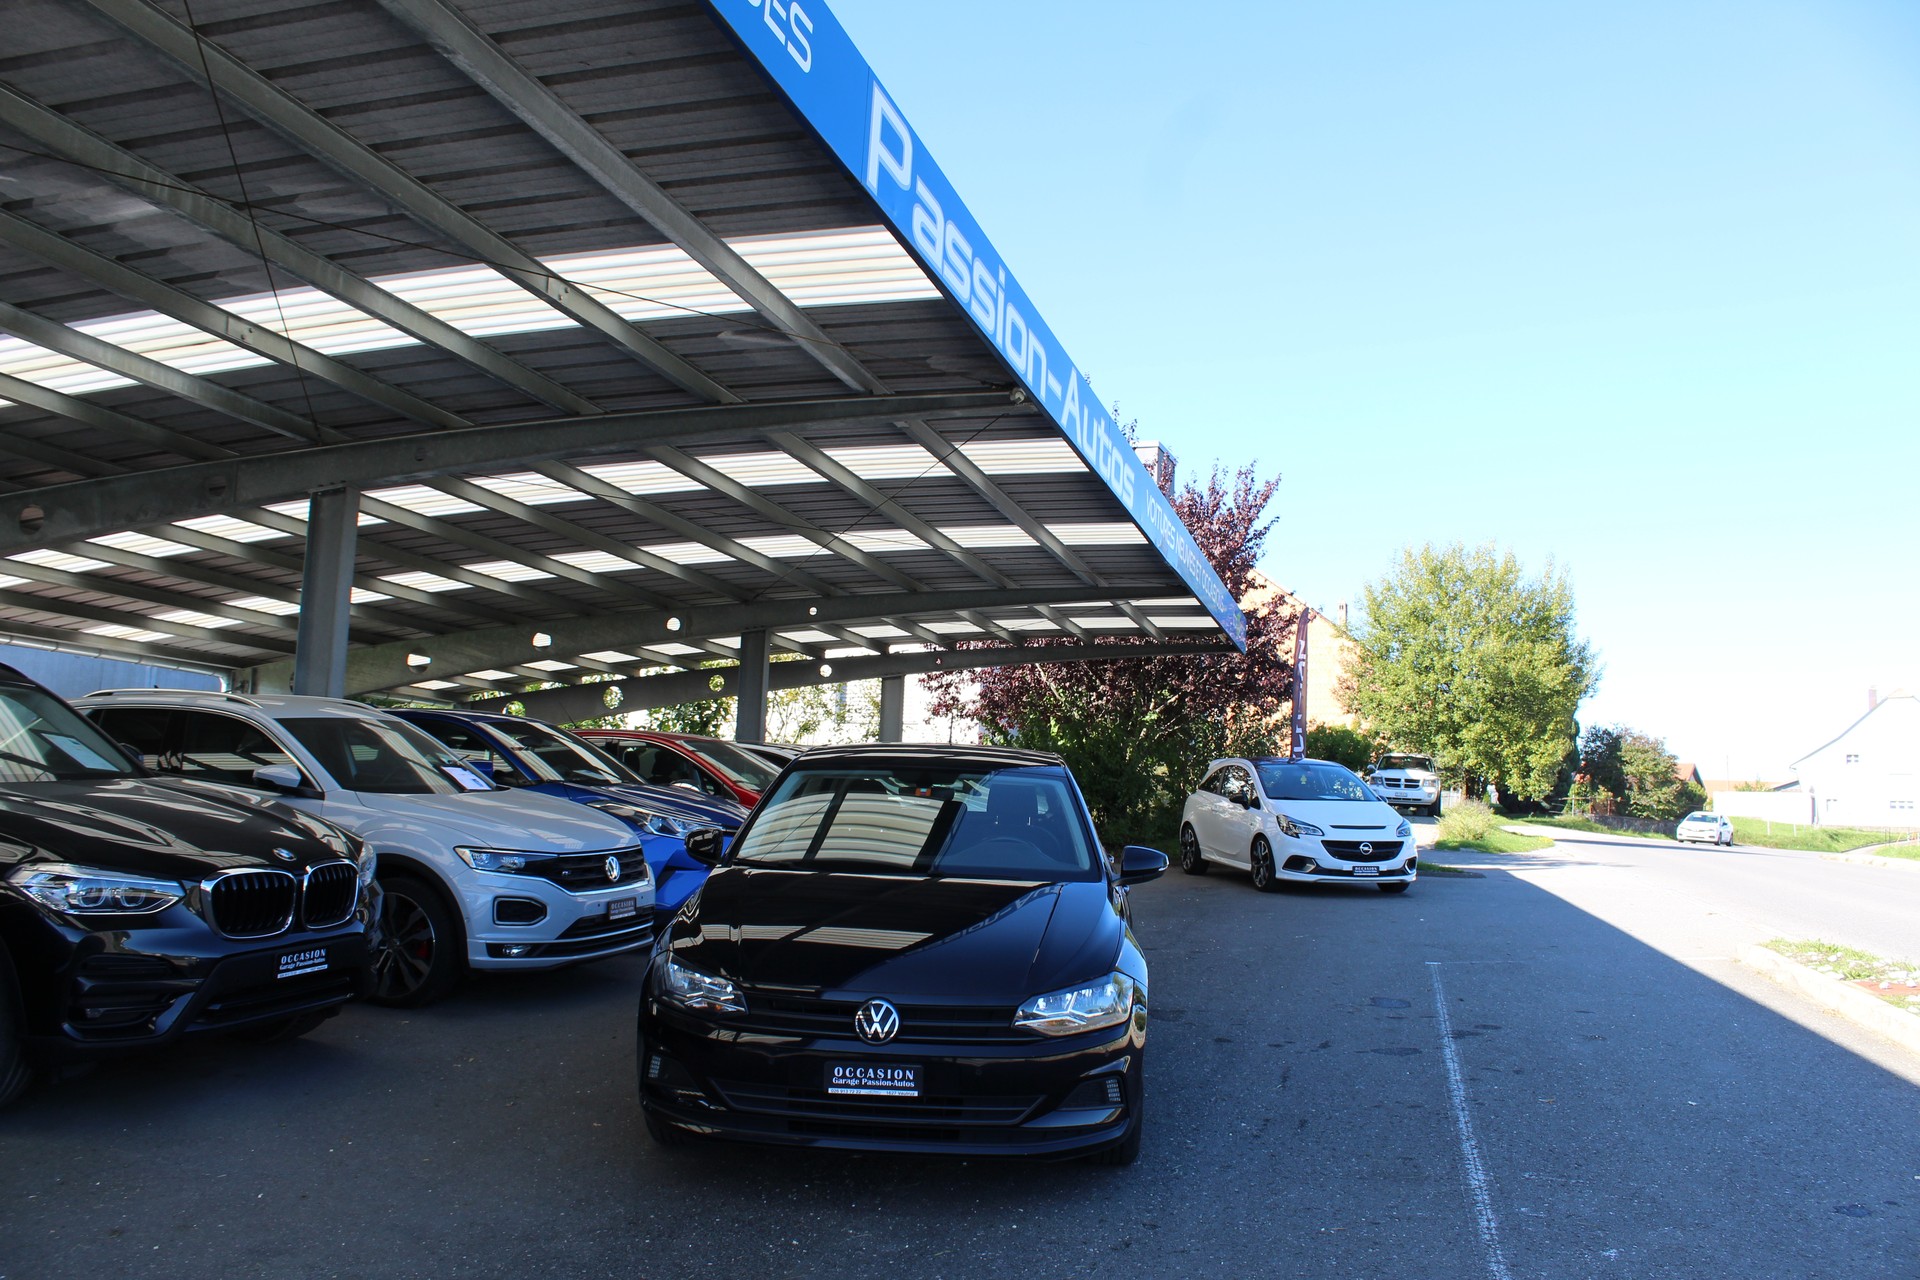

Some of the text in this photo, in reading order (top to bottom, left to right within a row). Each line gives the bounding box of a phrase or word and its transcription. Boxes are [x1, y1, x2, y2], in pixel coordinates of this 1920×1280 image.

[747, 0, 814, 74] ES
[866, 80, 1135, 511] Passion-Autos
[1145, 489, 1176, 551] VOITURES
[281, 948, 326, 964] OCCASION
[832, 1077, 915, 1088] Garage Passion-Autos
[834, 1066, 914, 1080] OCCASION
